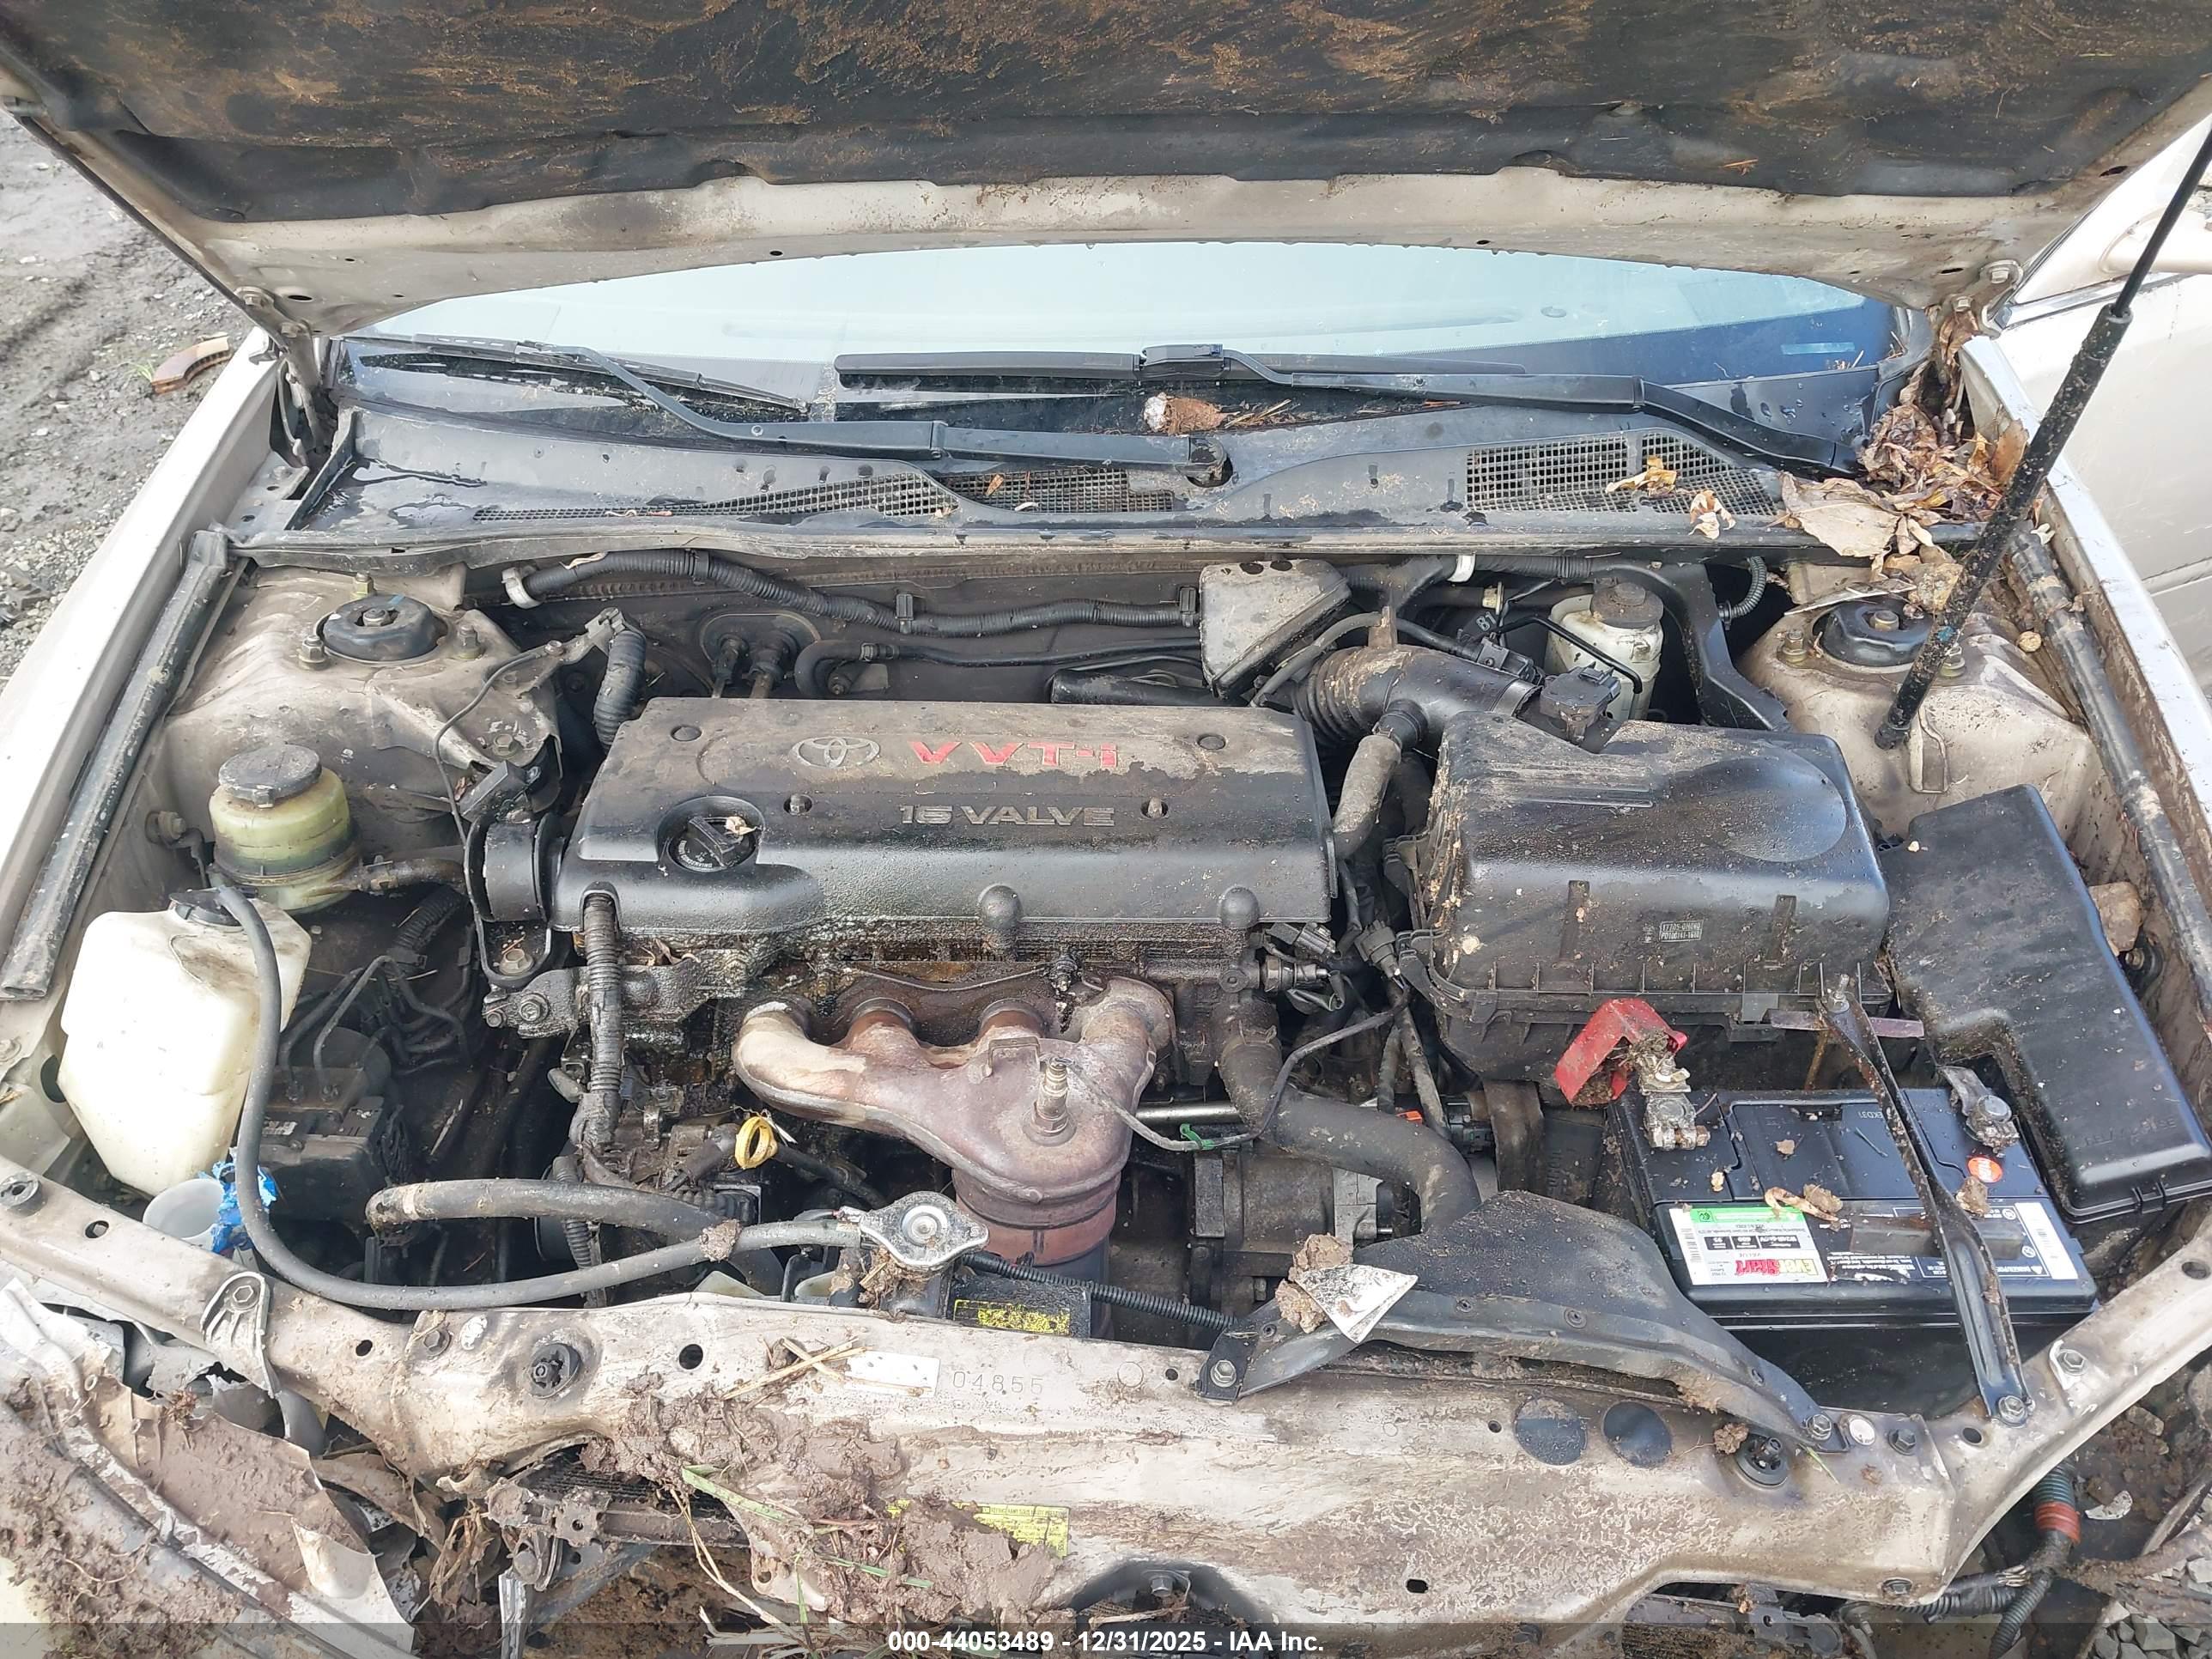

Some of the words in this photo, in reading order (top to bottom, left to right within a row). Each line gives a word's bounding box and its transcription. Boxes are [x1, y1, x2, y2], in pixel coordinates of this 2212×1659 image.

[899, 805, 953, 825] 16
[961, 805, 1115, 826] VALVE
[952, 1371, 1043, 1395] 04855
